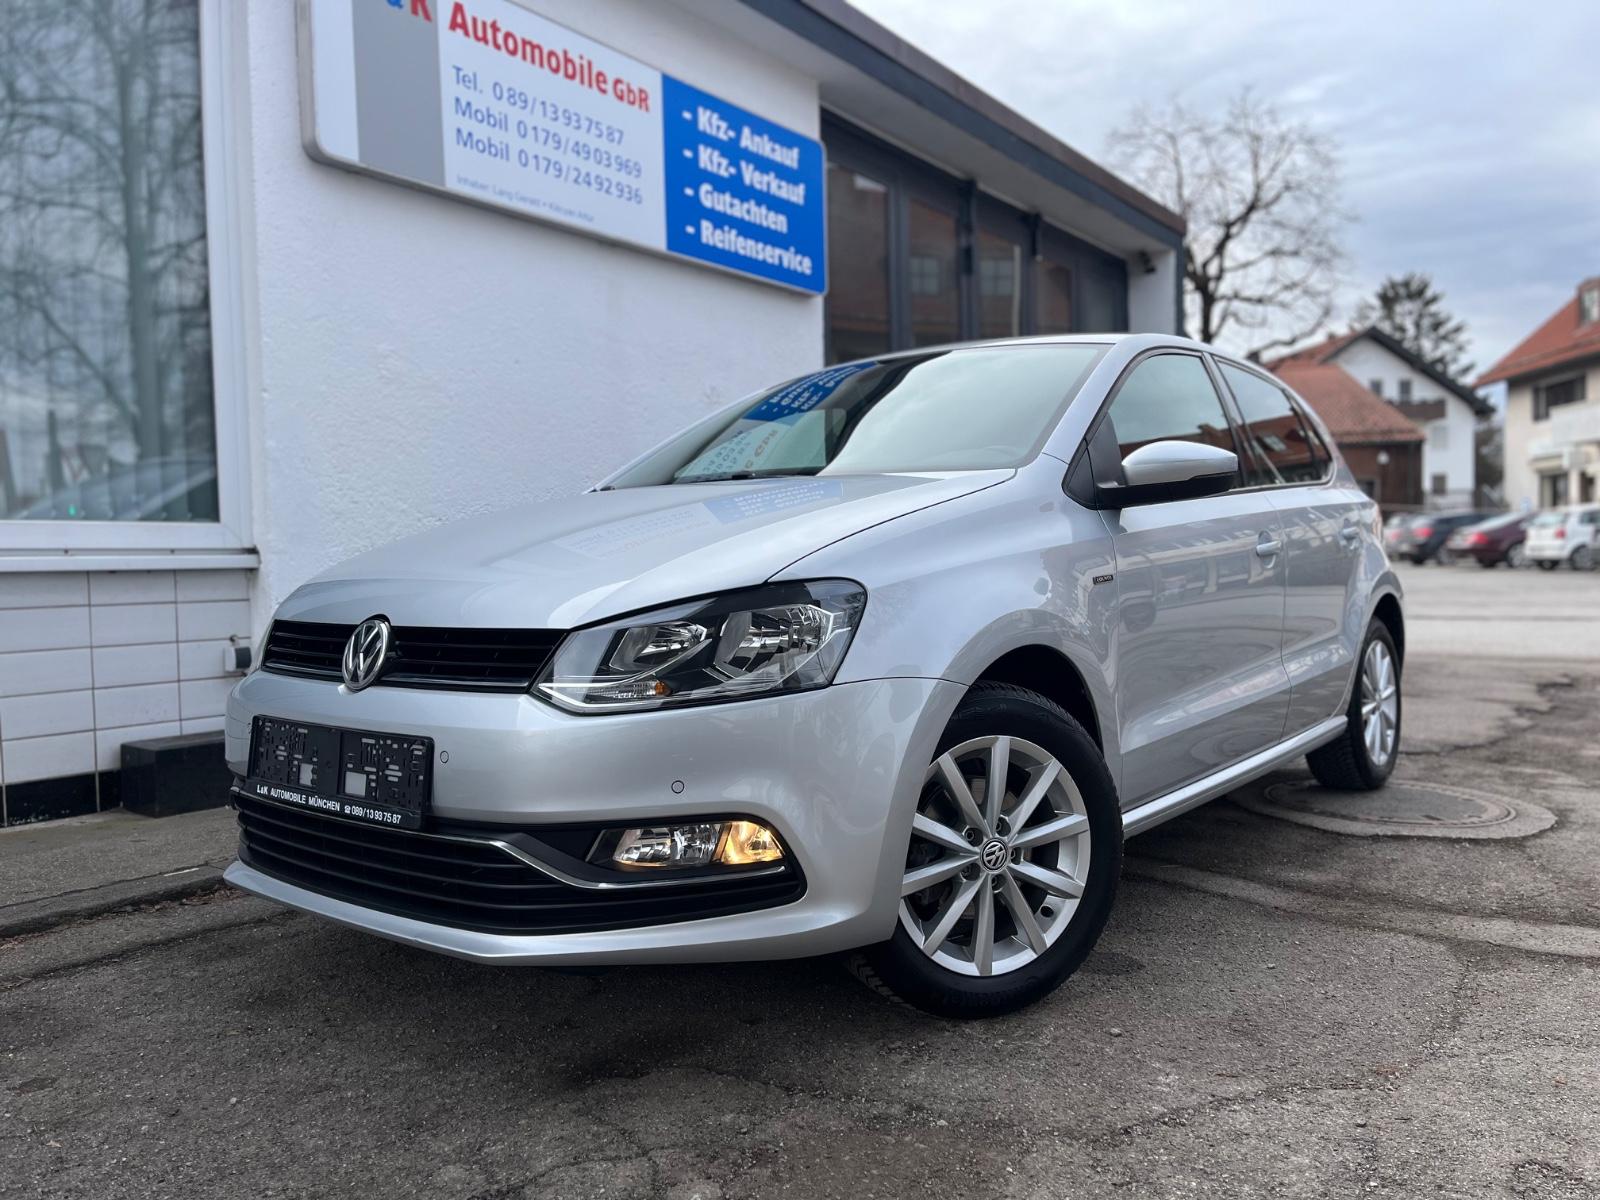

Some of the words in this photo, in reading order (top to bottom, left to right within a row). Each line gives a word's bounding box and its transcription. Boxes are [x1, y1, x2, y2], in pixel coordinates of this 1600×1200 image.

[448, 1, 608, 95] Automobile
[612, 78, 650, 112] GbR
[452, 65, 483, 94] Tel.
[454, 96, 509, 132] Mobil
[697, 106, 736, 142] Kfz-
[739, 125, 800, 170] Ankauf
[456, 127, 510, 162] Mobil
[697, 143, 737, 179] Kfz-
[739, 159, 806, 206] Verkauf
[698, 182, 788, 235] Gutachten
[700, 218, 813, 276] Reifenservice
[270, 787, 306, 804] AUTOMOBILE
[308, 796, 341, 812] MÜNCHEN
